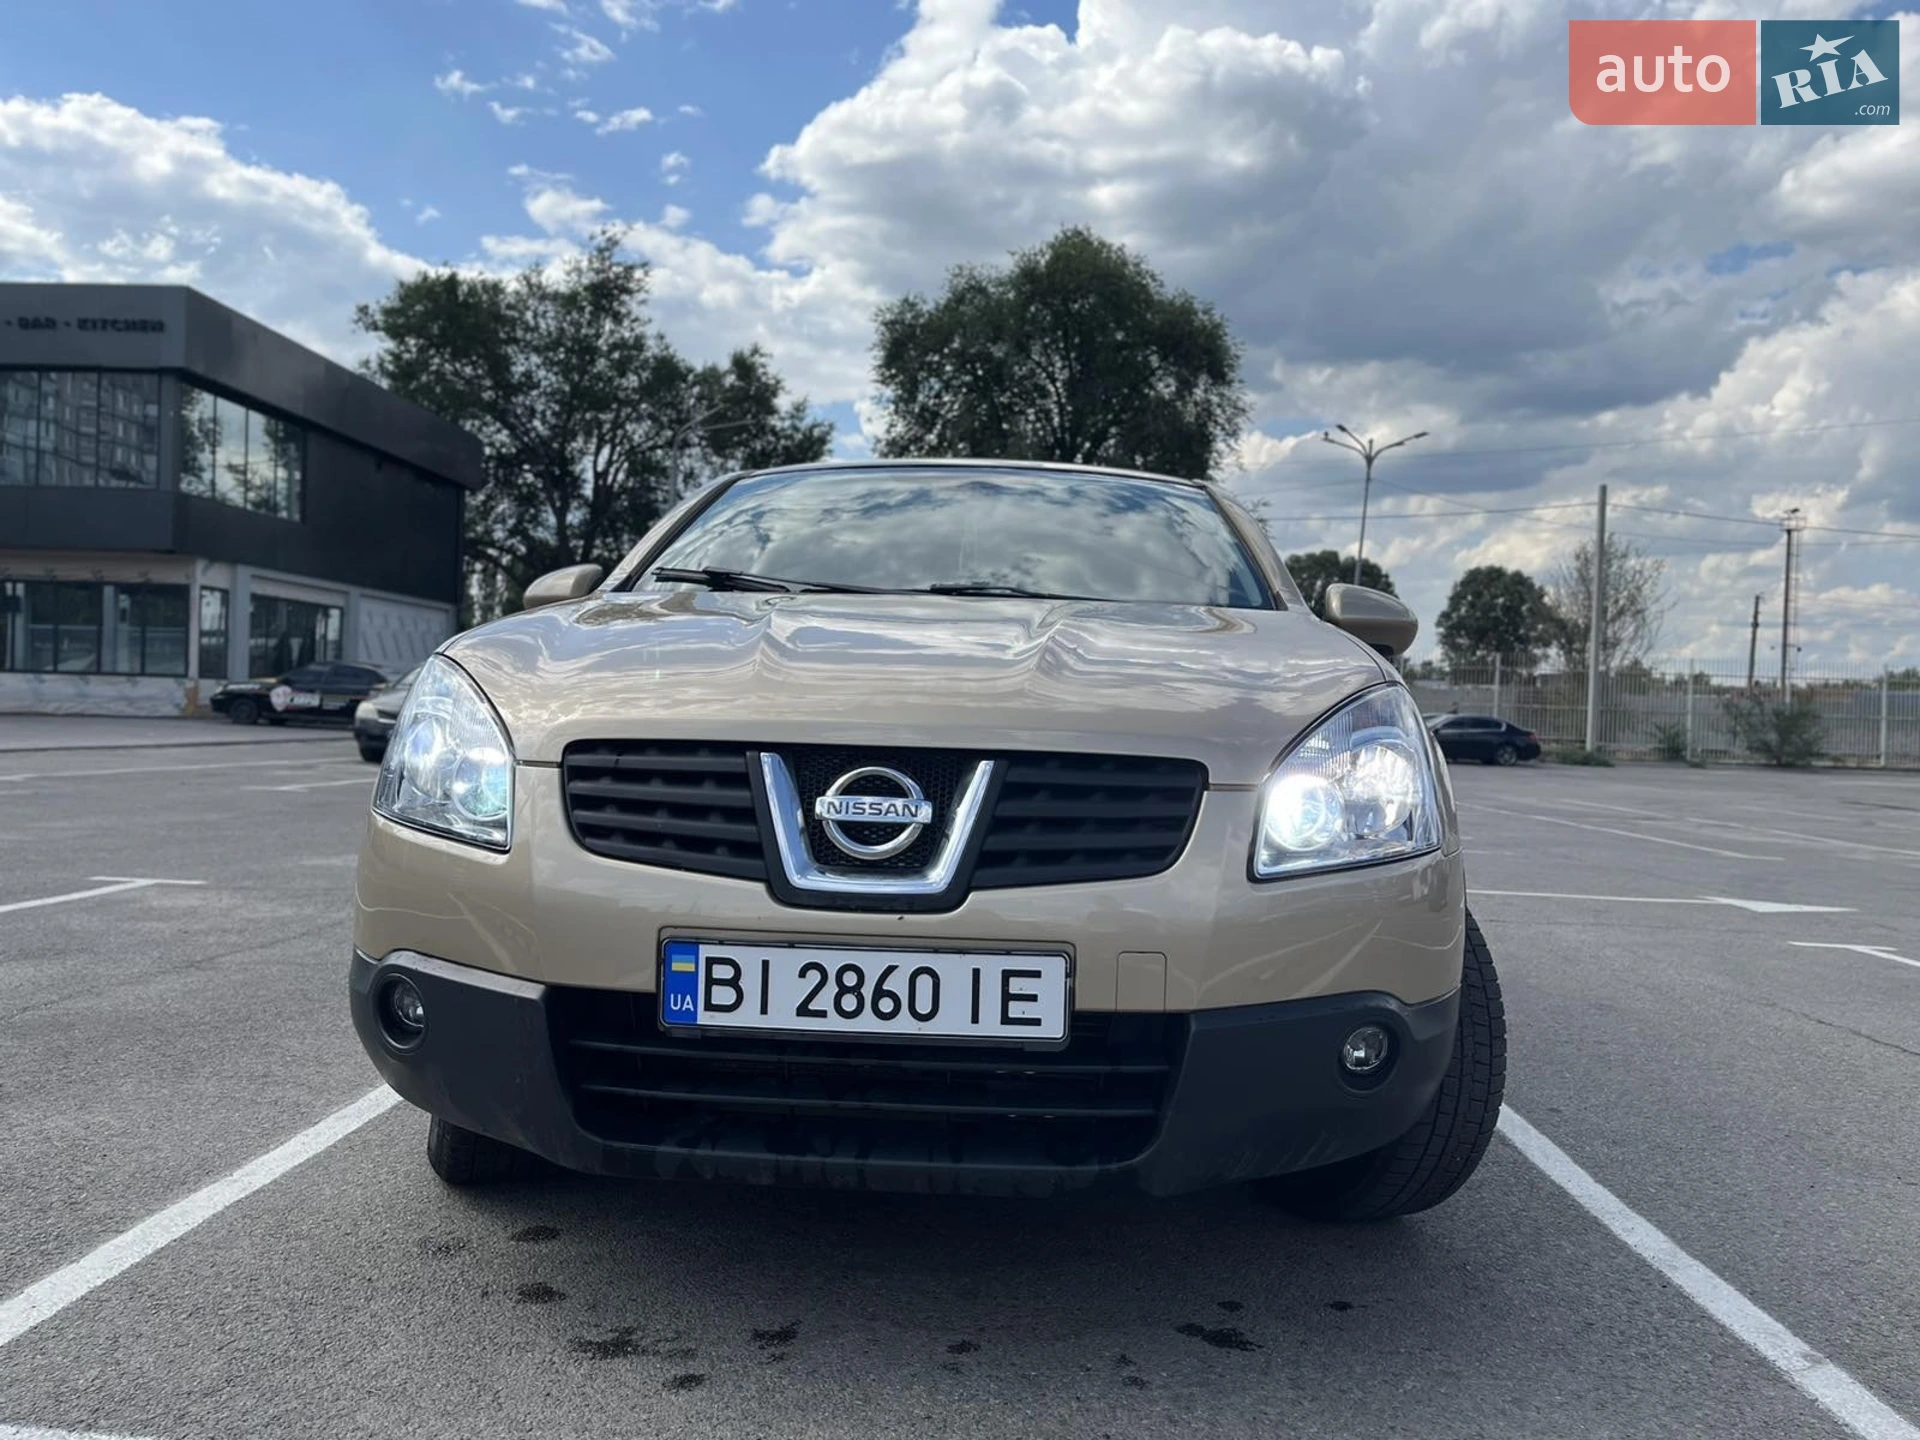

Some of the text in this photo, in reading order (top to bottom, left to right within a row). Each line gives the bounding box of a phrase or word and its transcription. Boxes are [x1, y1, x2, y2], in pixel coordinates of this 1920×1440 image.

[827, 801, 919, 818] NISSAN
[704, 955, 1042, 1027] BI 2860 IE
[670, 993, 694, 1012] UA
